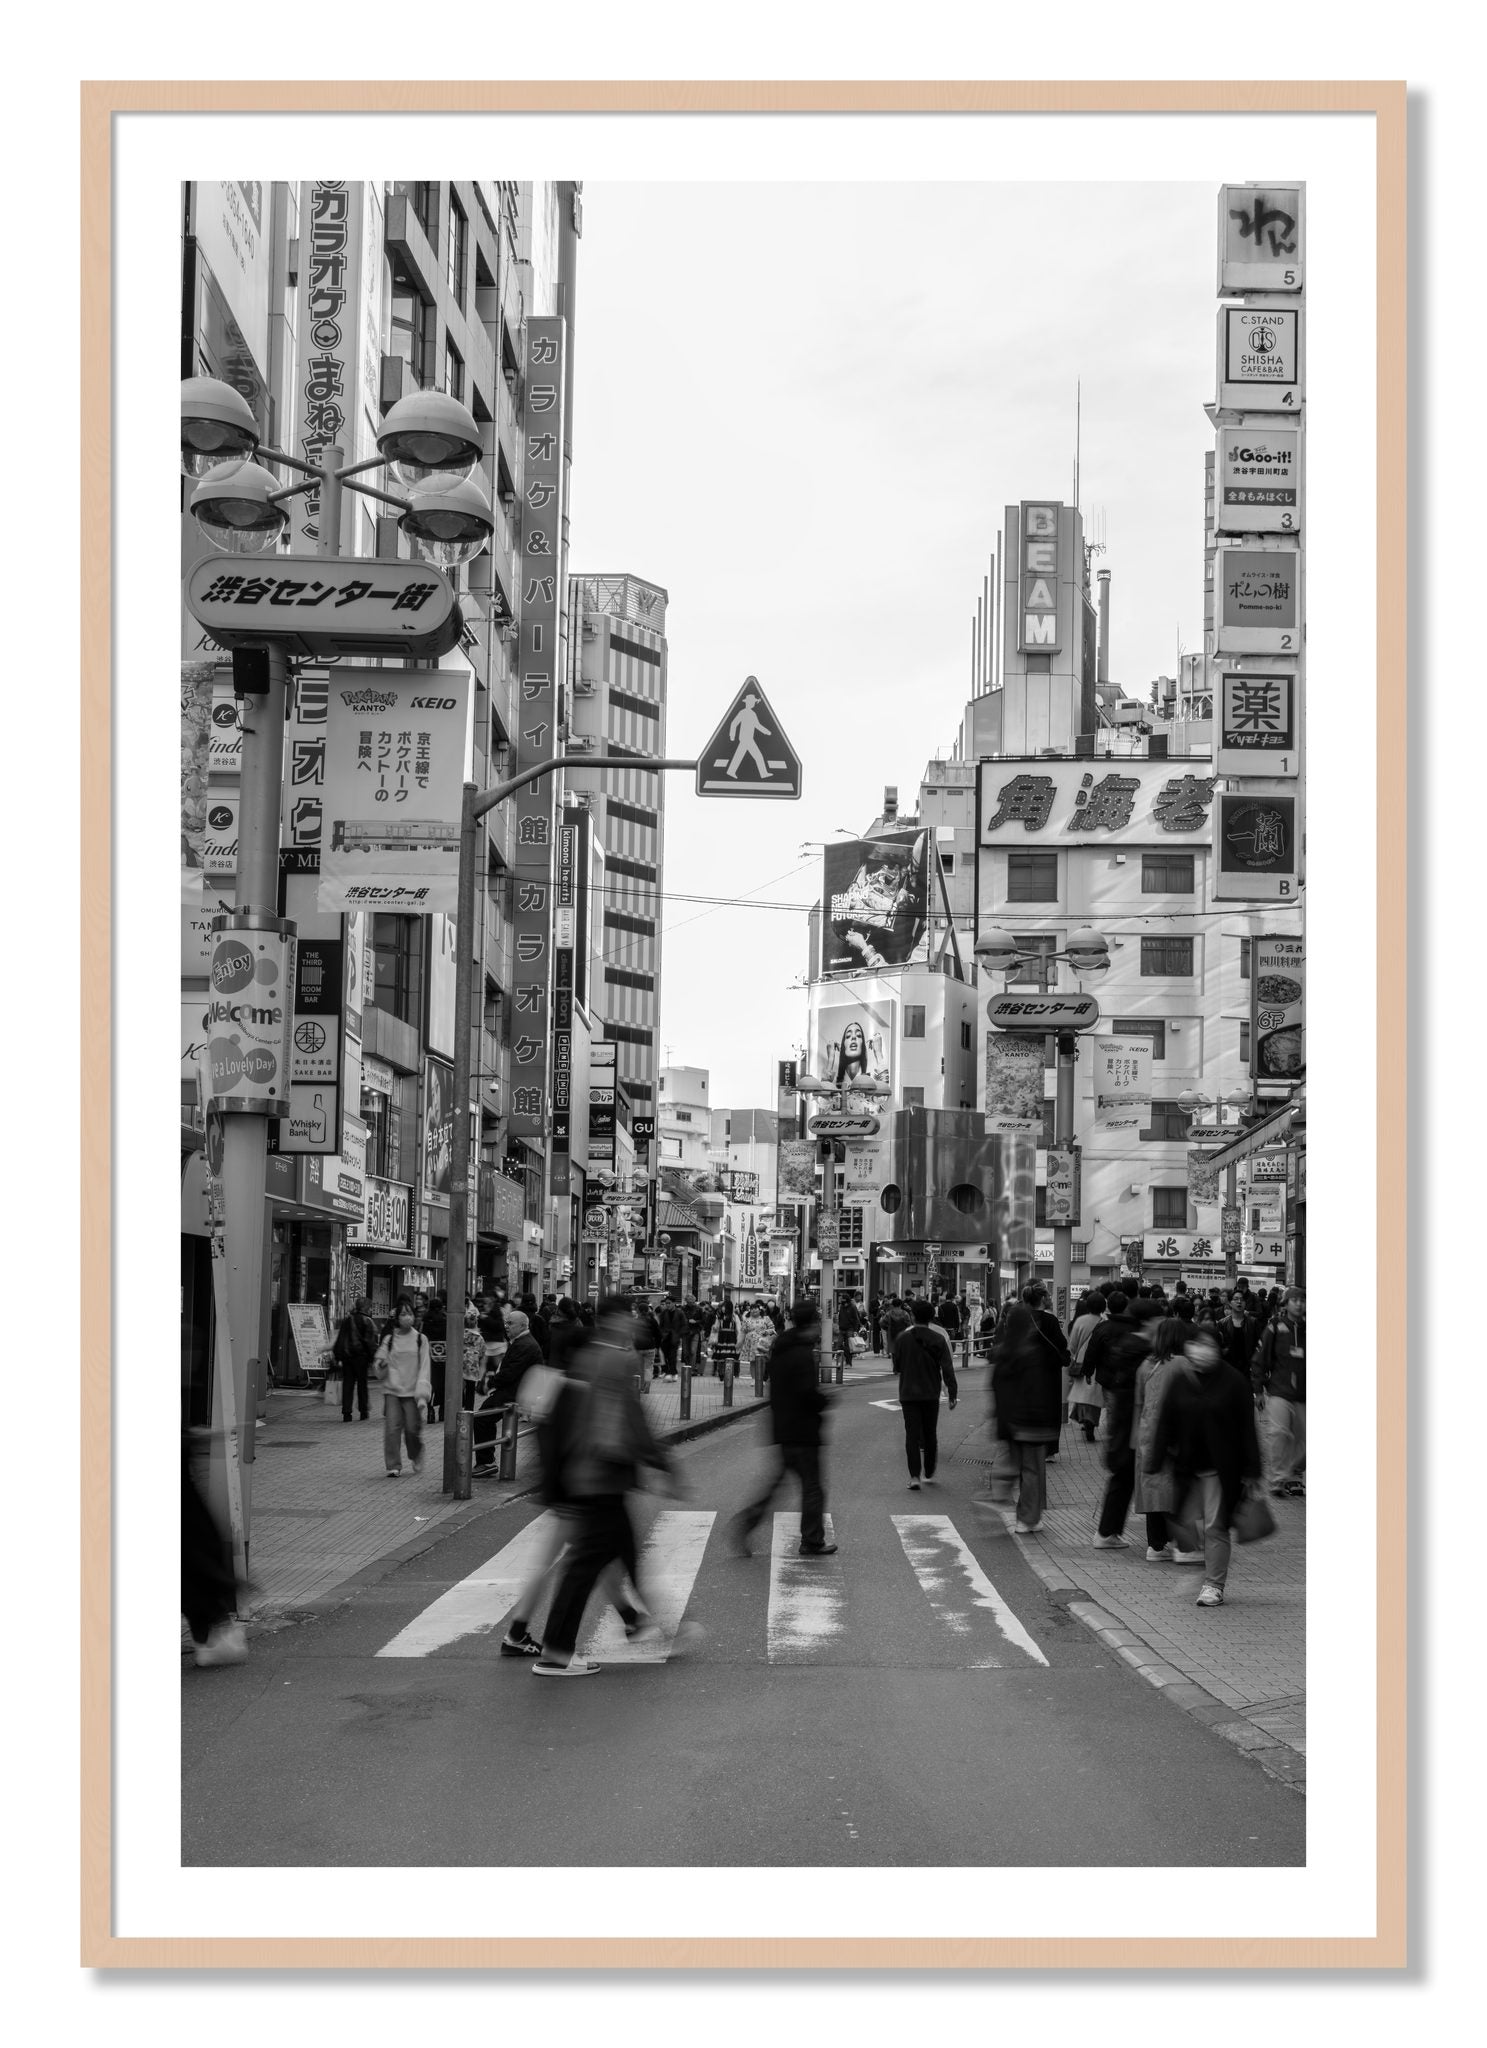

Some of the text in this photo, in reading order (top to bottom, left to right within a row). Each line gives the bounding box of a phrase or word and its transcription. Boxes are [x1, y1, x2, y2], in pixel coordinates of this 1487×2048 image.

[309, 189, 349, 321] カラオケ
[1284, 271, 1295, 285] 5
[1241, 316, 1284, 326] C.STAND
[1241, 355, 1283, 365] SHISHA
[1241, 365, 1283, 374] CAFE&BAR
[1282, 391, 1294, 406] 4
[1240, 448, 1291, 463] Goo-it!
[1233, 467, 1288, 476] 渋谷宇田川町店
[1228, 491, 1293, 502] 全身もみほぐし
[1281, 513, 1293, 528] 3
[1026, 506, 1057, 645] BEAM
[200, 575, 439, 611] 渋谷センター街
[1281, 635, 1292, 649] 2
[410, 697, 457, 710] KEIO
[1232, 681, 1280, 729] 薬
[1227, 733, 1286, 746] マツモトキヨシ
[291, 656, 335, 845] ラオケ
[357, 731, 373, 772] 冒険へ
[213, 757, 236, 766] 渋谷店
[375, 731, 392, 802] カントーの
[415, 731, 431, 789] 京王線で
[1280, 757, 1288, 773] 1
[988, 773, 1214, 832] 角海老
[209, 860, 232, 868] 渋谷店
[562, 830, 571, 902] kimono hearts
[345, 886, 430, 900] 渋谷センター街
[1280, 880, 1290, 895] B
[831, 892, 868, 904] SHAPING
[1259, 955, 1301, 968] 四川料理
[212, 953, 251, 986] Enjoy
[209, 1001, 283, 1025] Welcome
[994, 1002, 1093, 1015] 渋谷センター街
[1257, 1011, 1285, 1030] 6F
[226, 1057, 254, 1076] Lovely
[256, 1056, 275, 1071] Day!
[290, 1119, 322, 1130] Whisky
[634, 1122, 653, 1133] GU
[811, 1120, 871, 1129] 渋谷センター街
[289, 1128, 309, 1137] Bank
[1190, 1129, 1244, 1137] 渋谷センター街
[1157, 1237, 1214, 1257] 兆楽
[748, 1235, 756, 1276] BEER
